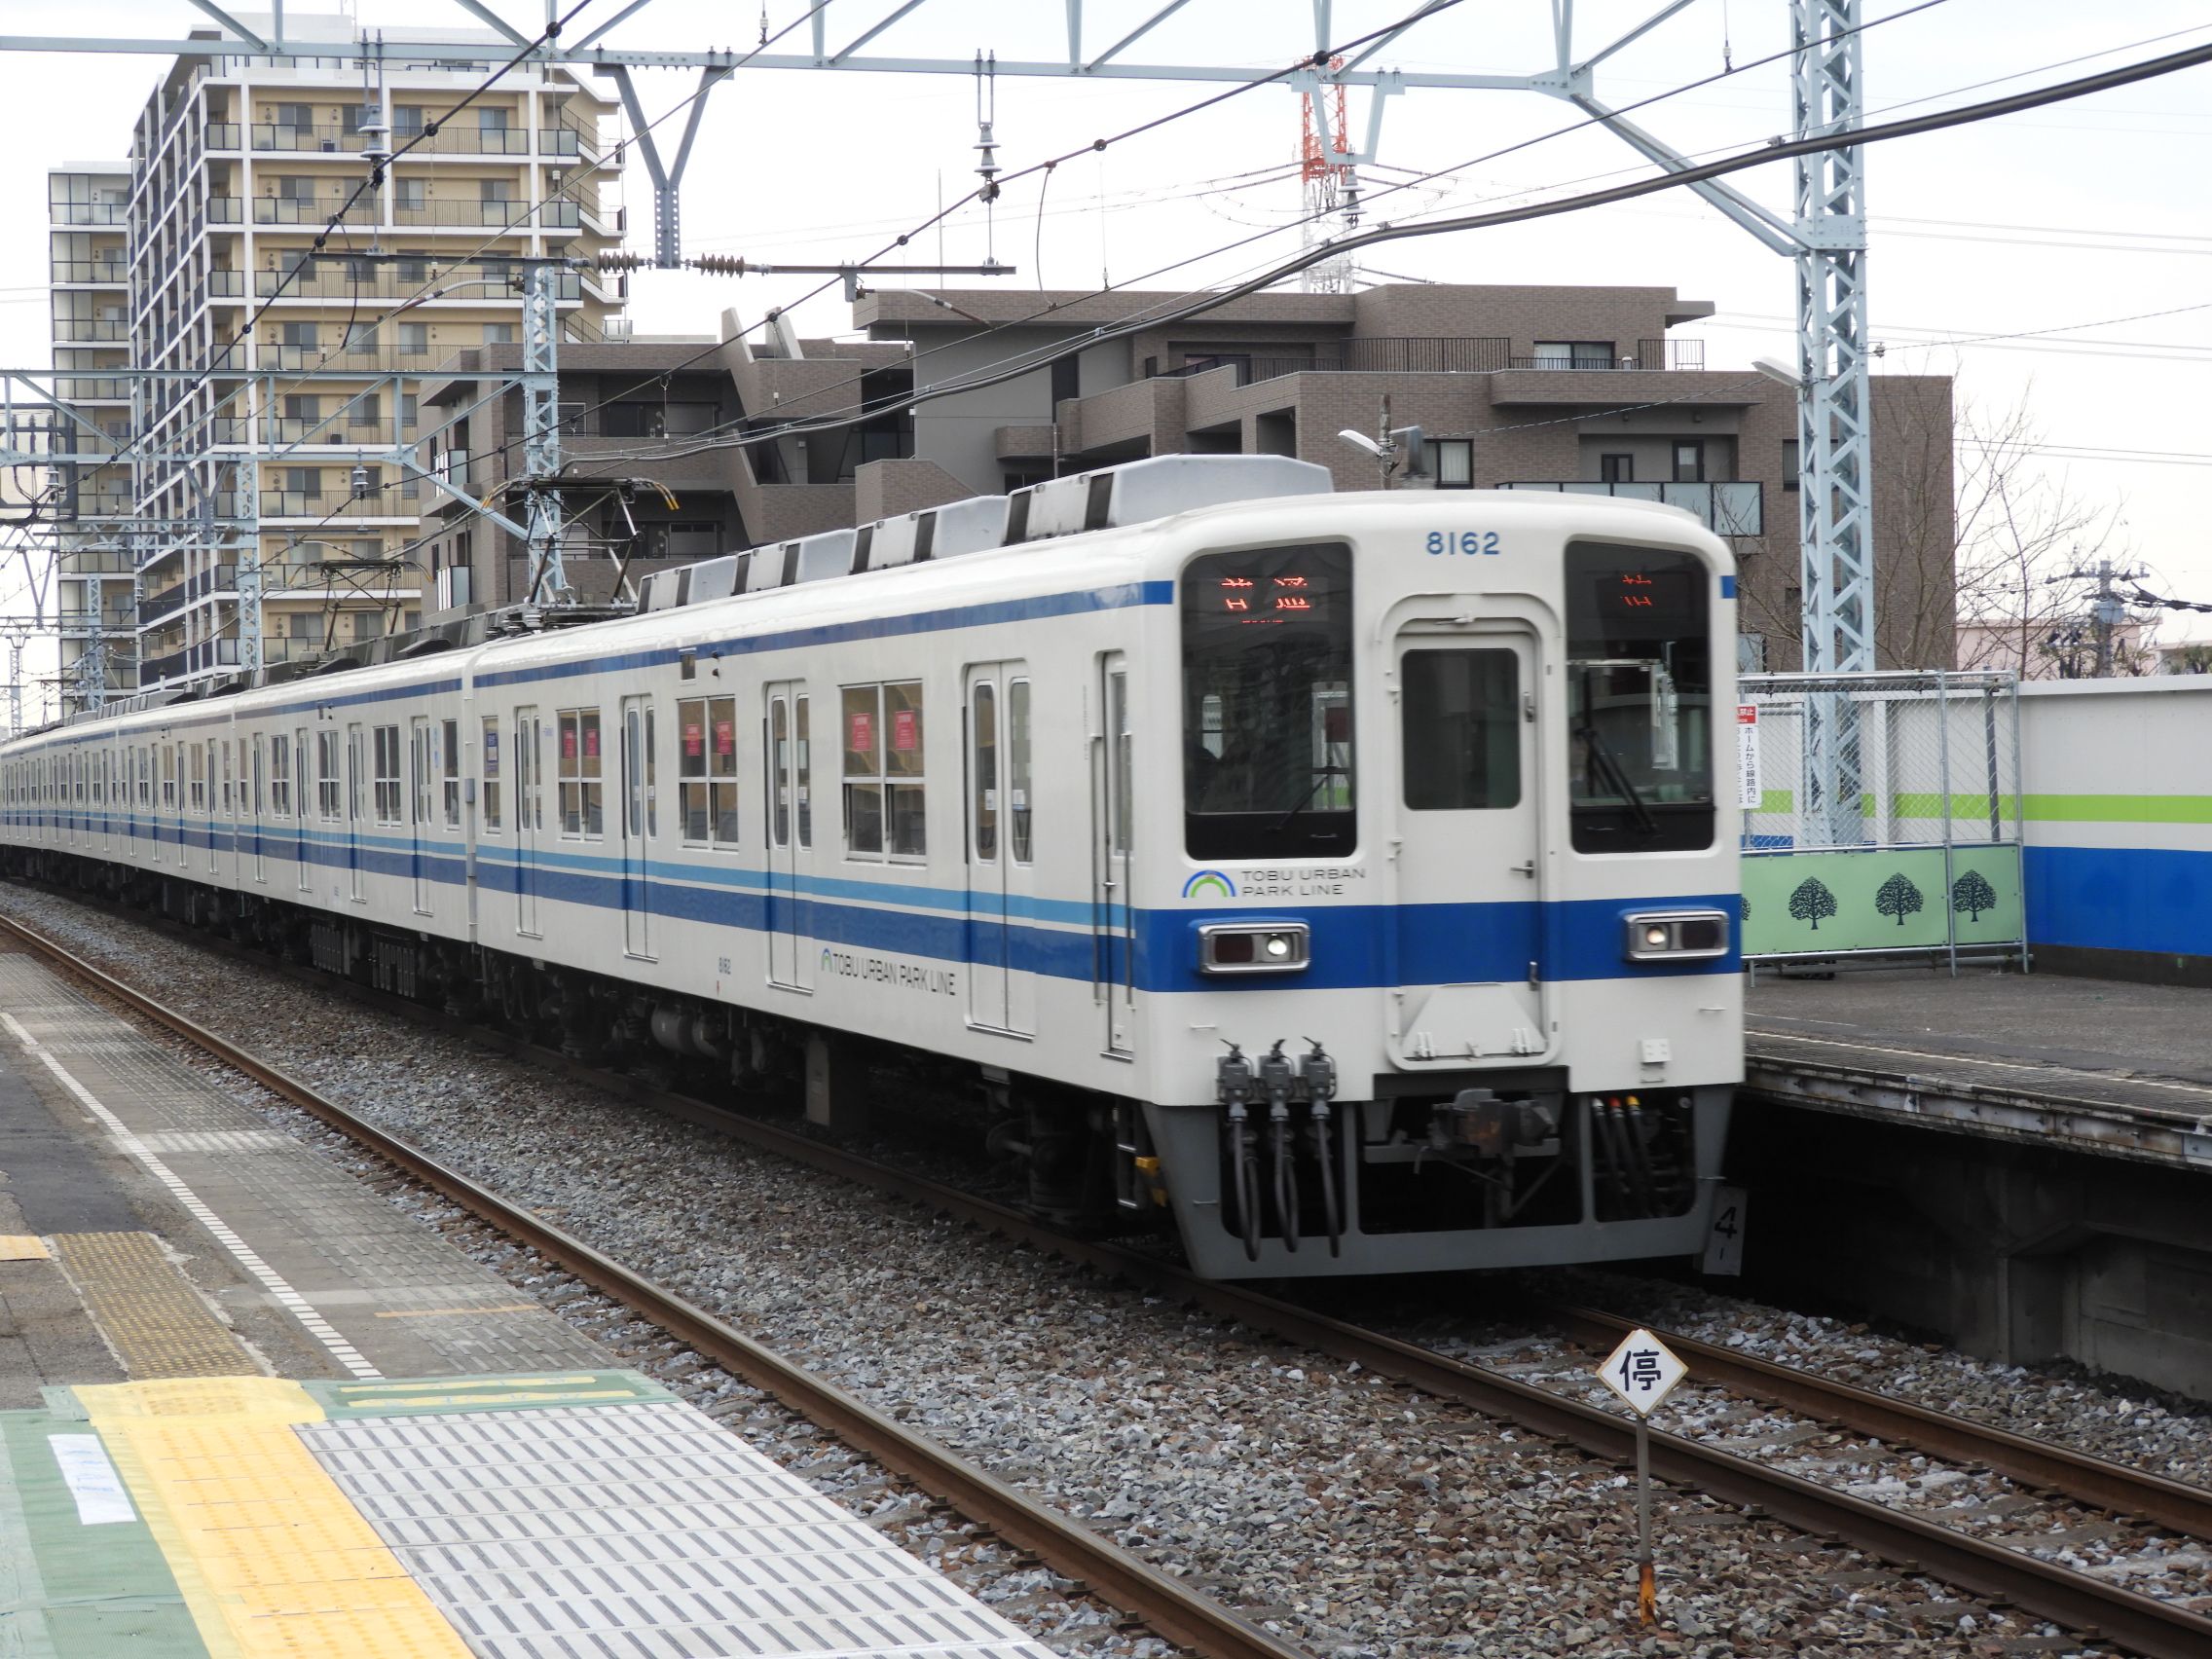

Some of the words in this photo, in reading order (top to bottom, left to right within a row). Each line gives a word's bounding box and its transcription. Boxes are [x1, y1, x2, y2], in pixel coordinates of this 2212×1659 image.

[1426, 532, 1500, 555] 8162
[1745, 726, 1756, 804] ホームから線路内に
[1241, 870, 1293, 882] TOBU
[1299, 868, 1366, 880] URBAN
[1241, 885, 1293, 897] PARK
[1300, 884, 1344, 896] LINE
[832, 953, 859, 977] TOBU
[861, 959, 898, 985] URBAN
[900, 965, 929, 991] PARK
[930, 970, 956, 996] LINE
[1714, 1206, 1738, 1239] 4
[1619, 1348, 1662, 1392] 停
